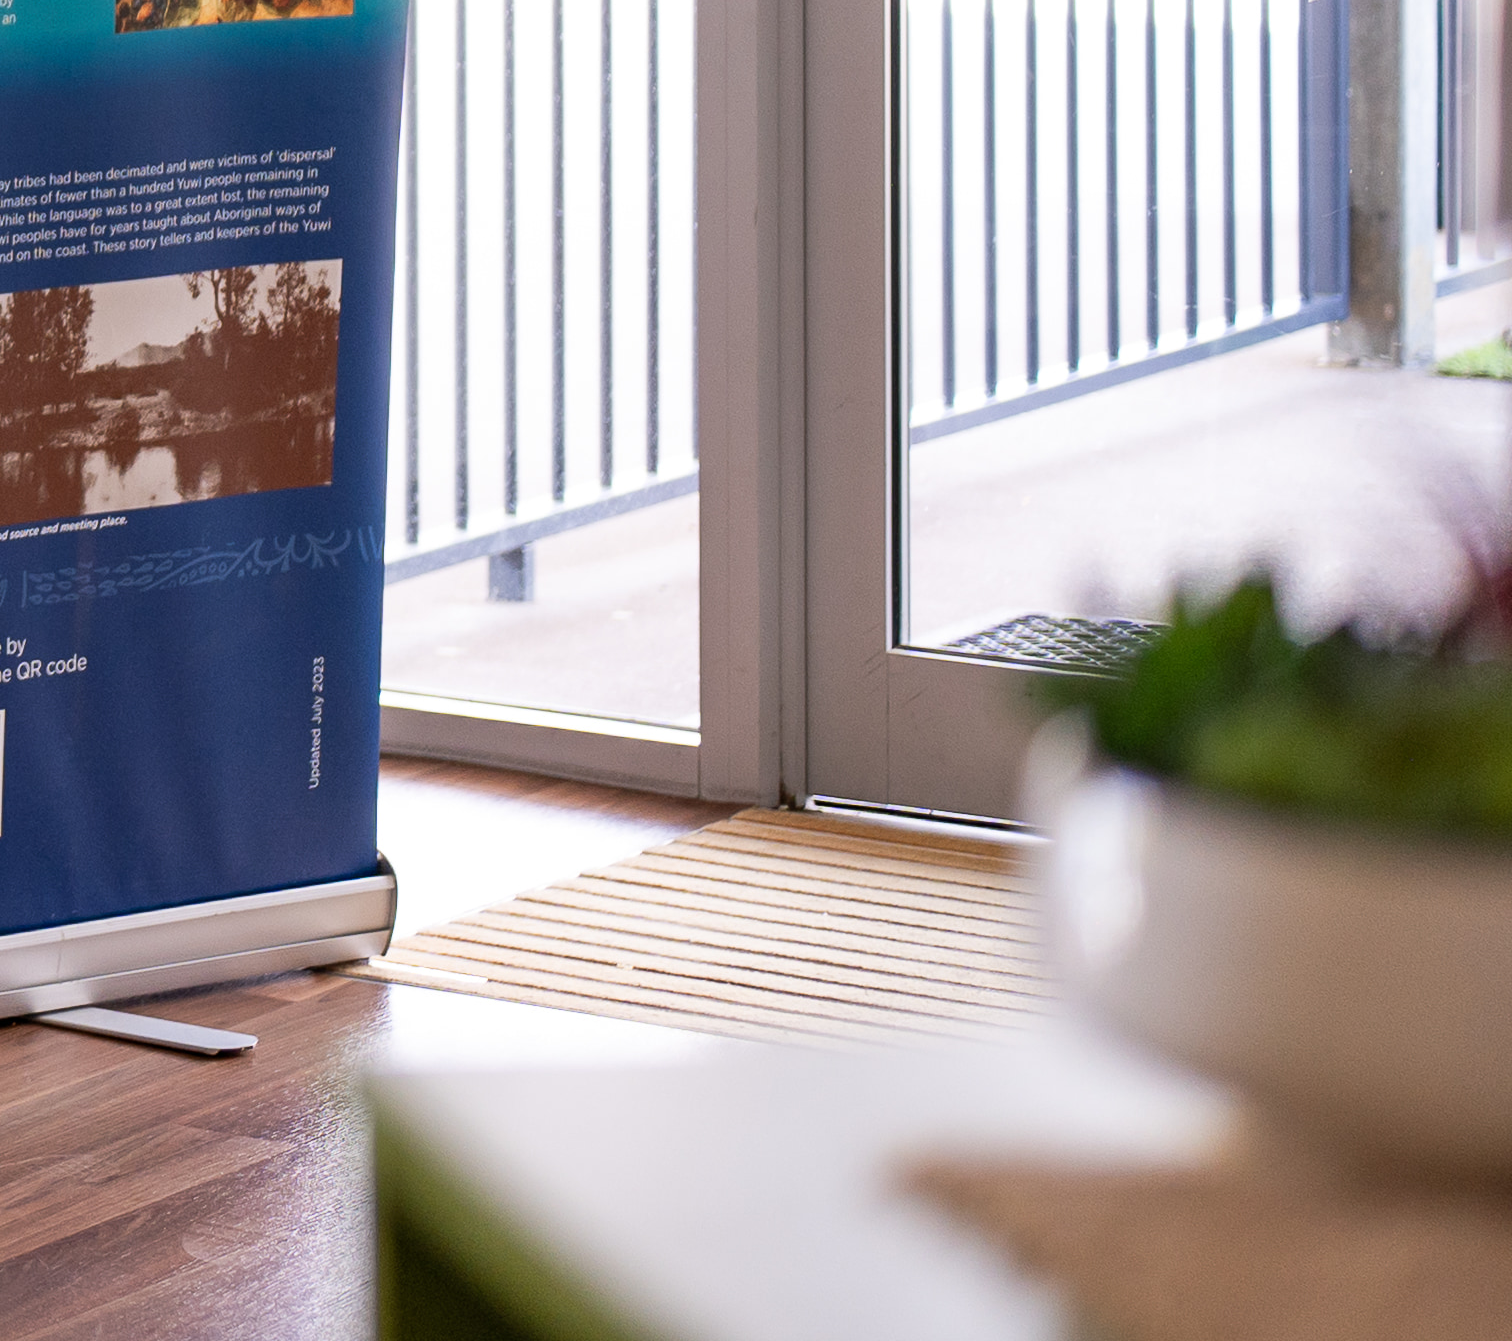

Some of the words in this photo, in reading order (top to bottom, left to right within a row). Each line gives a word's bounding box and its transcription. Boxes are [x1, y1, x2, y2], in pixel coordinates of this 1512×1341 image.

[5, 636, 27, 657] by
[15, 658, 42, 680] QR
[45, 652, 87, 676] code
[311, 655, 325, 693] 2023
[310, 695, 325, 725] July
[308, 728, 321, 789] Updated
